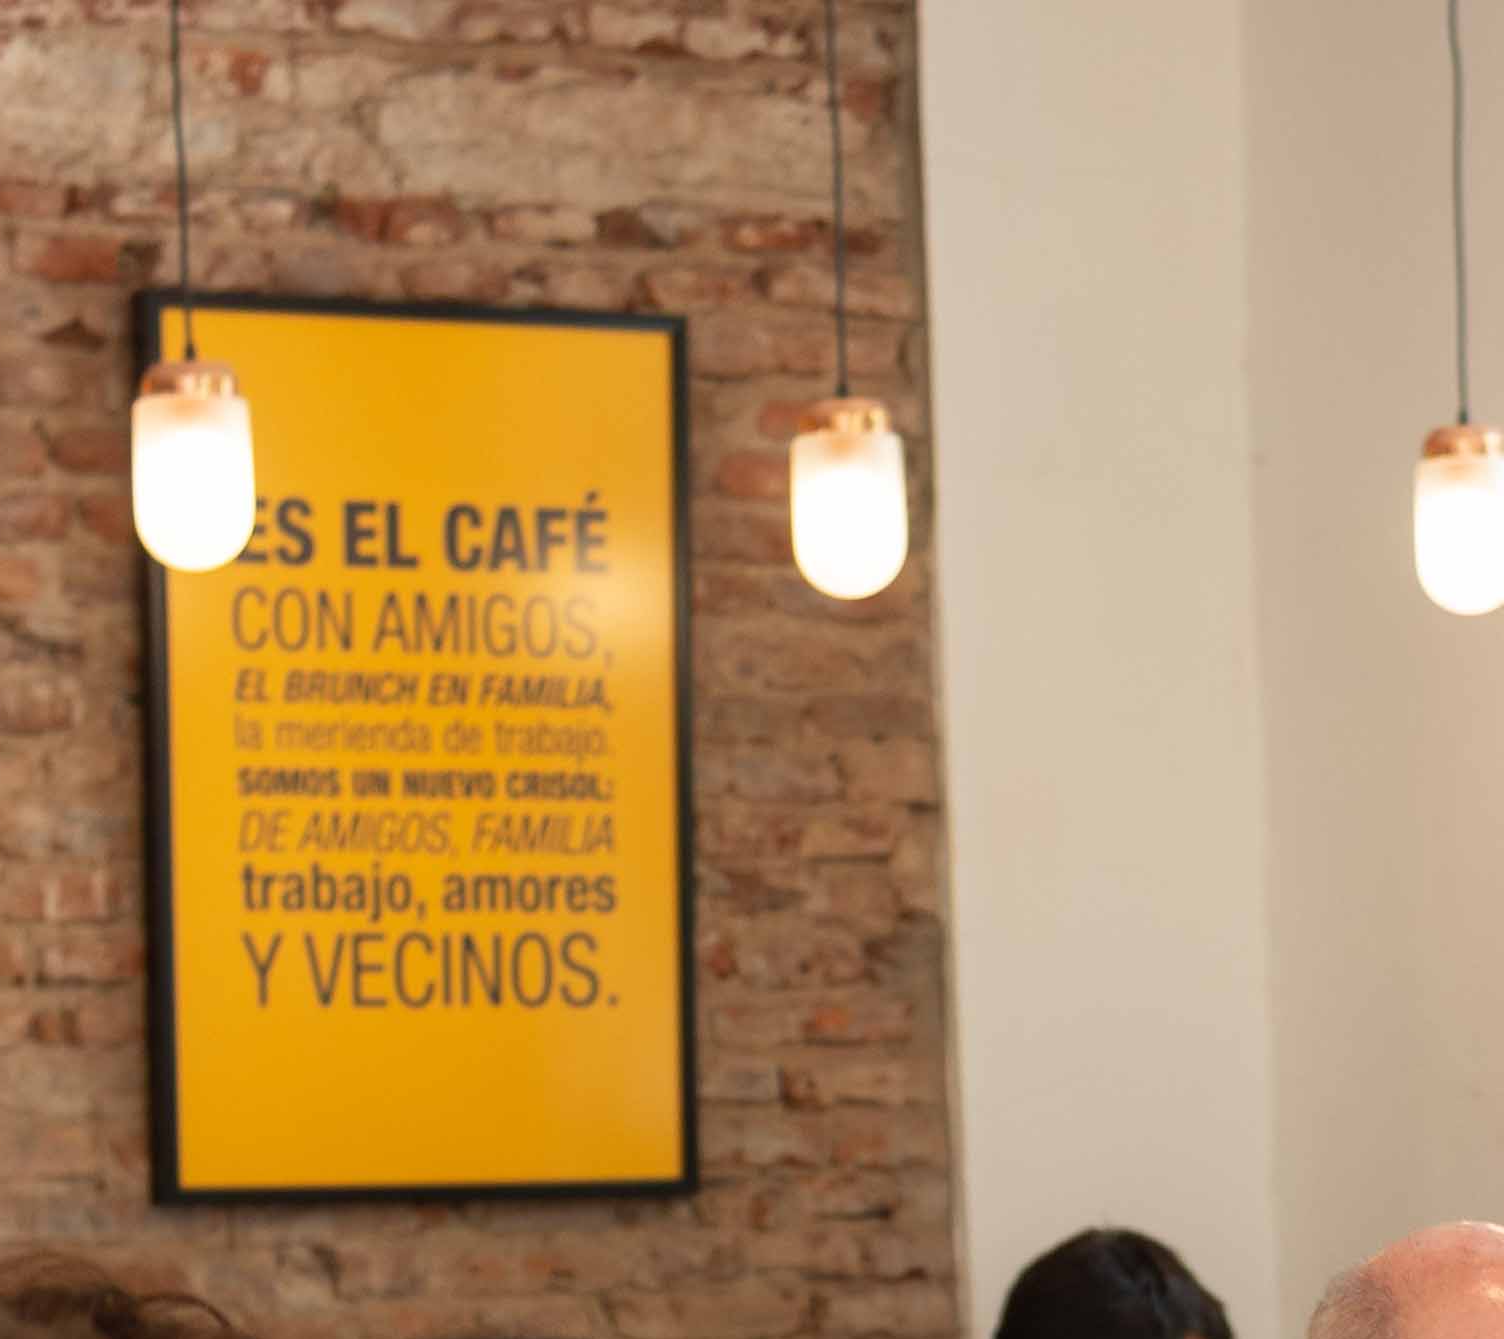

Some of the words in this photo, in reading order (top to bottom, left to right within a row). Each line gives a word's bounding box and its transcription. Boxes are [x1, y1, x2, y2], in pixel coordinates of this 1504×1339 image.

[344, 499, 417, 570] EL
[443, 489, 609, 573] CAFÉ
[231, 584, 354, 654] CON
[371, 591, 615, 668] AMIGOS,
[233, 668, 267, 703] EL
[283, 670, 420, 705] BRUNCH
[427, 672, 470, 706] EN
[478, 672, 614, 717] FAMILIA,
[232, 714, 263, 752] la
[273, 717, 433, 753] merienda
[441, 719, 482, 754] de
[236, 767, 340, 797] SOMOS
[351, 768, 391, 798] UN
[401, 768, 496, 798] NUEVO
[239, 808, 293, 853] DE
[300, 810, 458, 858] AMIGOS,
[241, 862, 427, 924] trabajo,
[442, 872, 617, 913] amores
[241, 932, 283, 1008] Y
[304, 932, 619, 1008] VECINOS.
